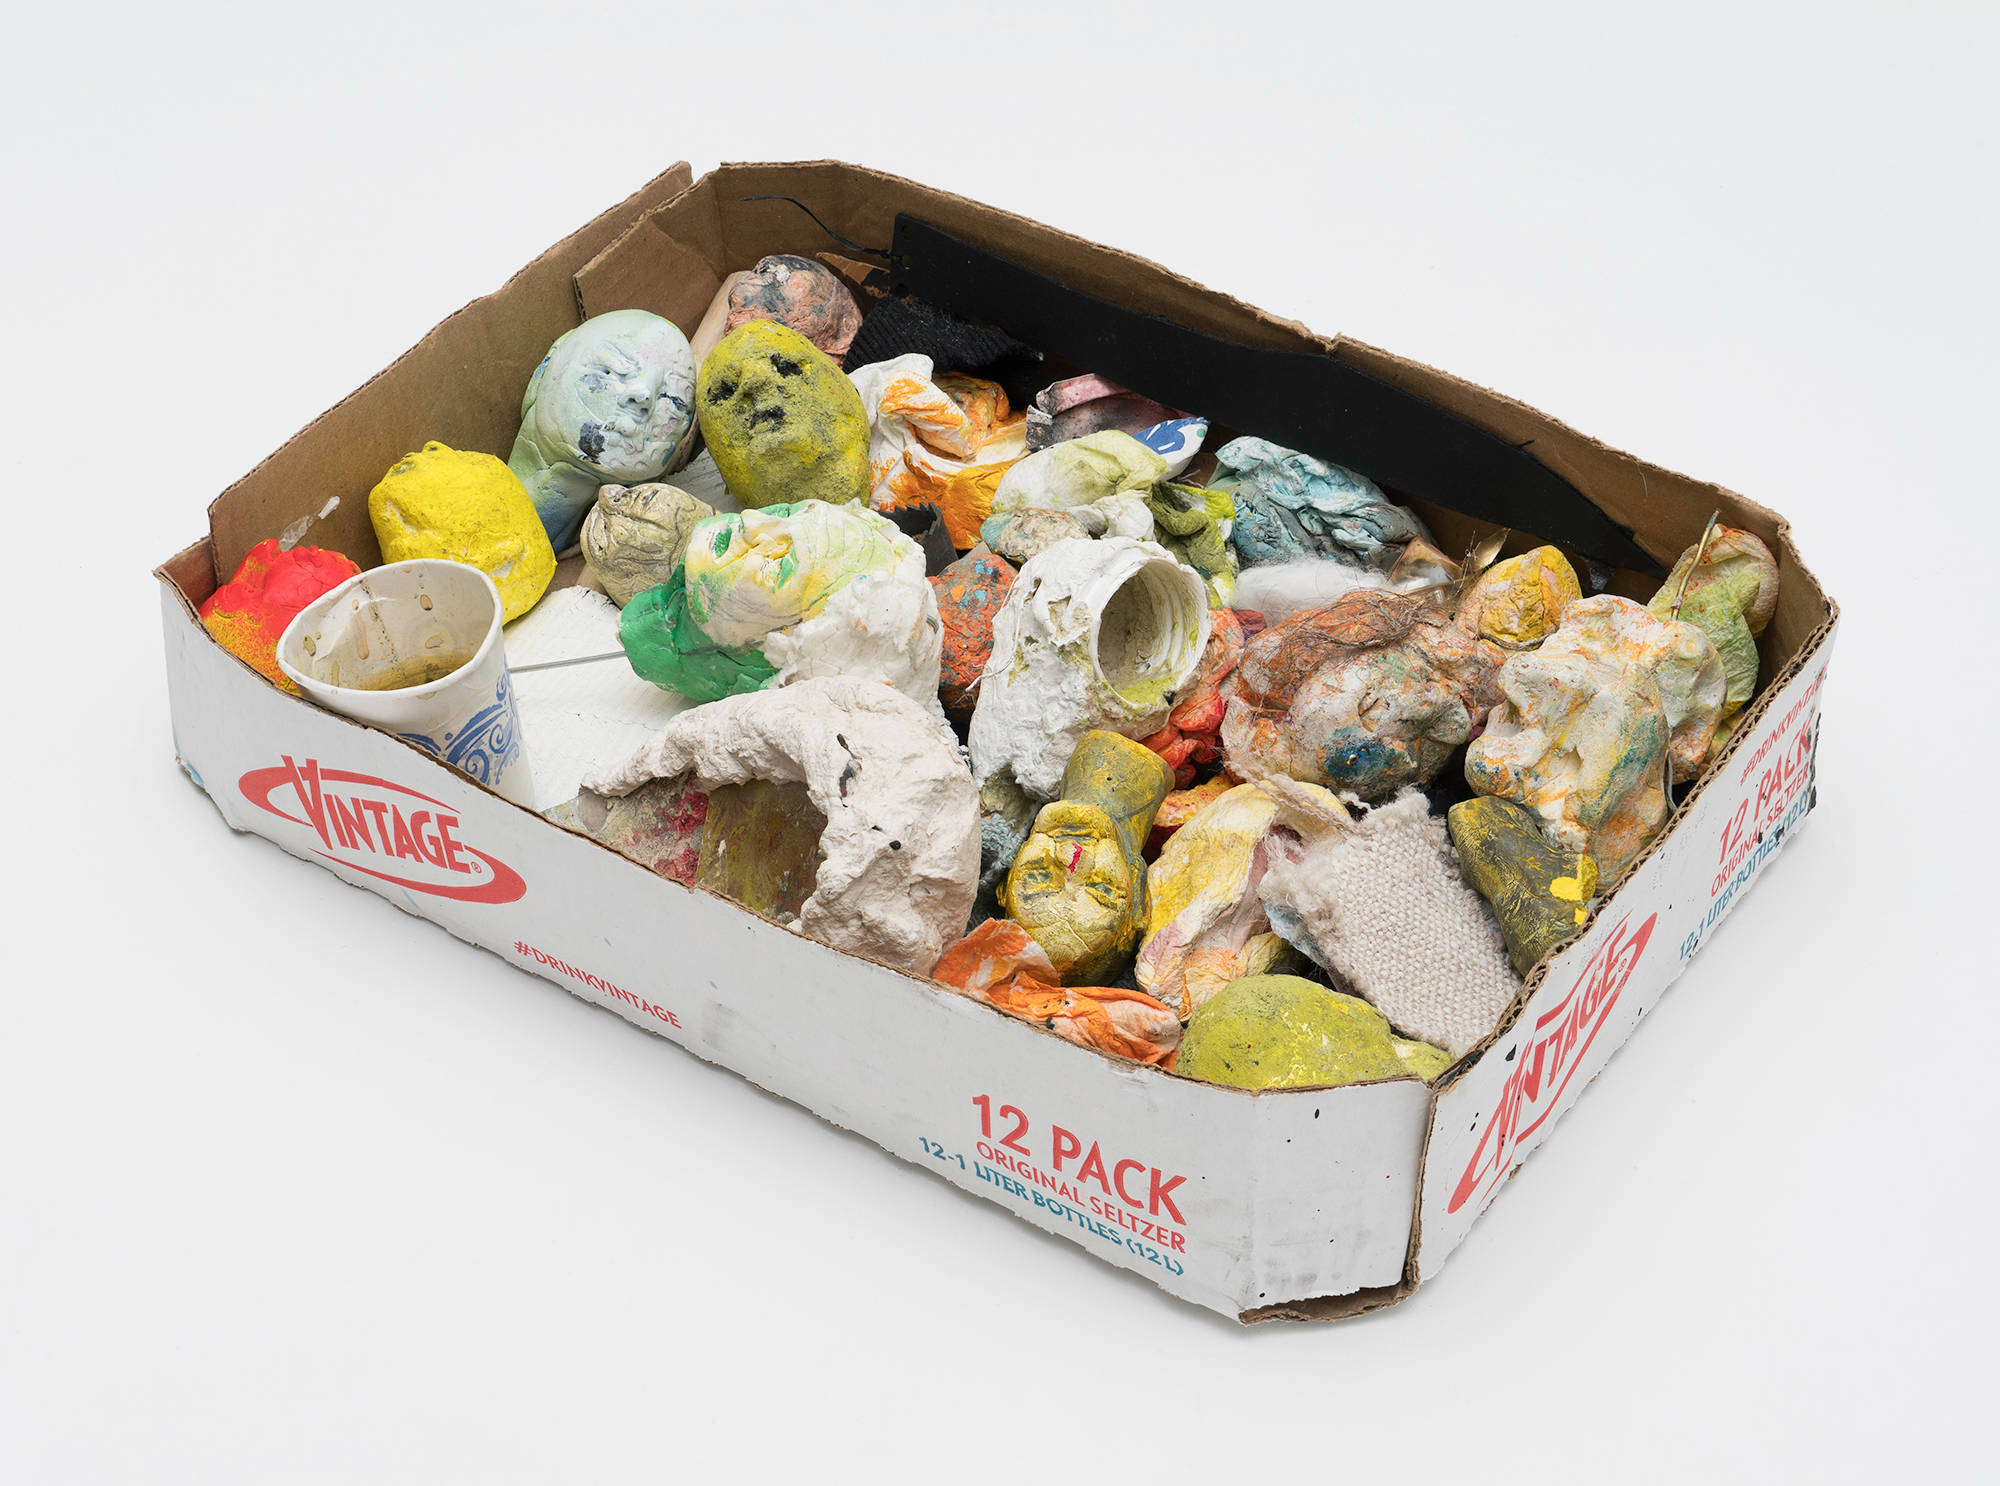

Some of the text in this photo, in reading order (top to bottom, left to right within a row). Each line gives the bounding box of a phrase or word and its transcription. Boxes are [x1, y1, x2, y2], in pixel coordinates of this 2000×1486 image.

[281, 755, 472, 874] VINTAGE
[1711, 761, 1810, 897] ORIGINAL SELTZER
[1720, 704, 1816, 865] 12 PACK
[1706, 882, 1735, 928] LITER
[513, 940, 683, 1029] #DRINKVINTAGE
[1494, 920, 1629, 1171] VINTAGE
[918, 1136, 966, 1170] 12-1
[974, 1161, 1030, 1201] LITER
[1031, 1189, 1123, 1246] BOTTLES
[972, 1094, 1187, 1226] 12 PACK
[976, 1141, 1186, 1254] ORIGINAL SELTZER
